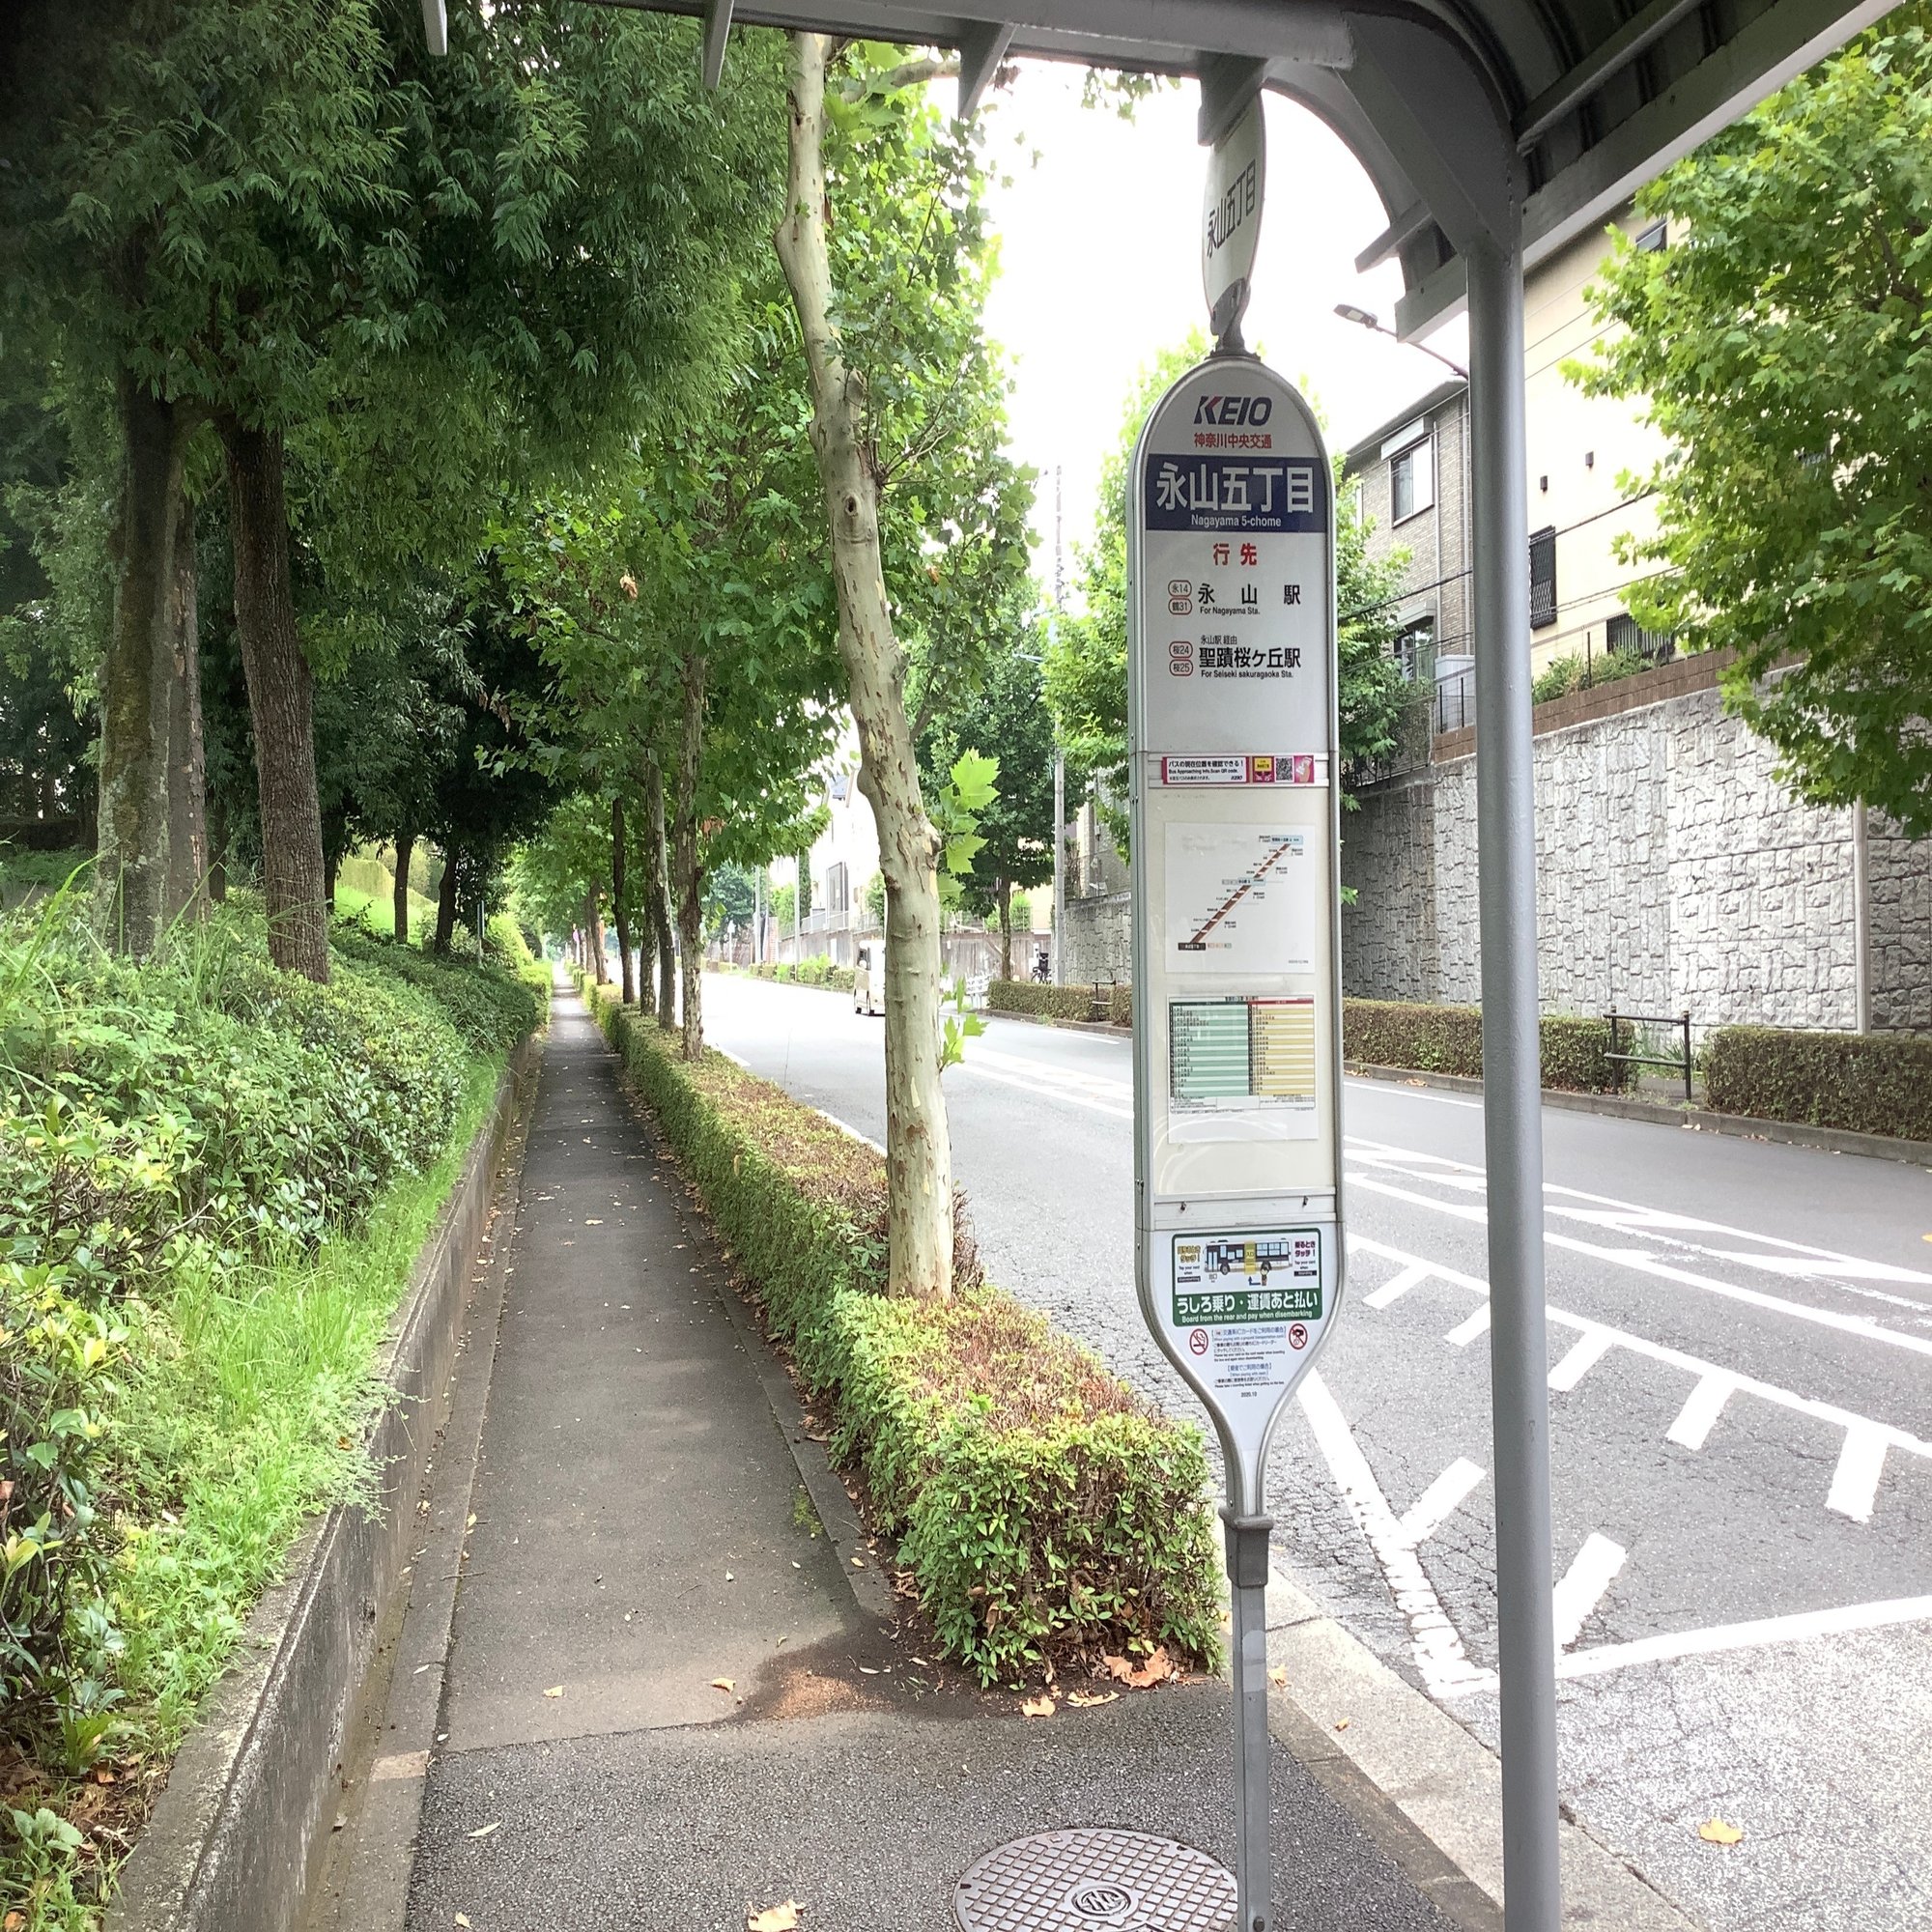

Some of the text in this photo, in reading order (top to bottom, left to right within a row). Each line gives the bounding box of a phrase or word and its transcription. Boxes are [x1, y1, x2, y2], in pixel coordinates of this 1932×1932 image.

[1207, 158, 1256, 258] 永山五丁目
[1194, 396, 1272, 426] KEIO
[1194, 433, 1271, 448] 神奈川中央交通
[1156, 462, 1313, 513] 永山五丁目
[1191, 515, 1281, 528] Nagayama 5-chome
[1212, 607, 1246, 616] Nagayama
[1248, 607, 1261, 615] Sta.
[1177, 1292, 1318, 1315] うしろ乗り・運賃あと払い
[1275, 1310, 1312, 1320] disembarking
